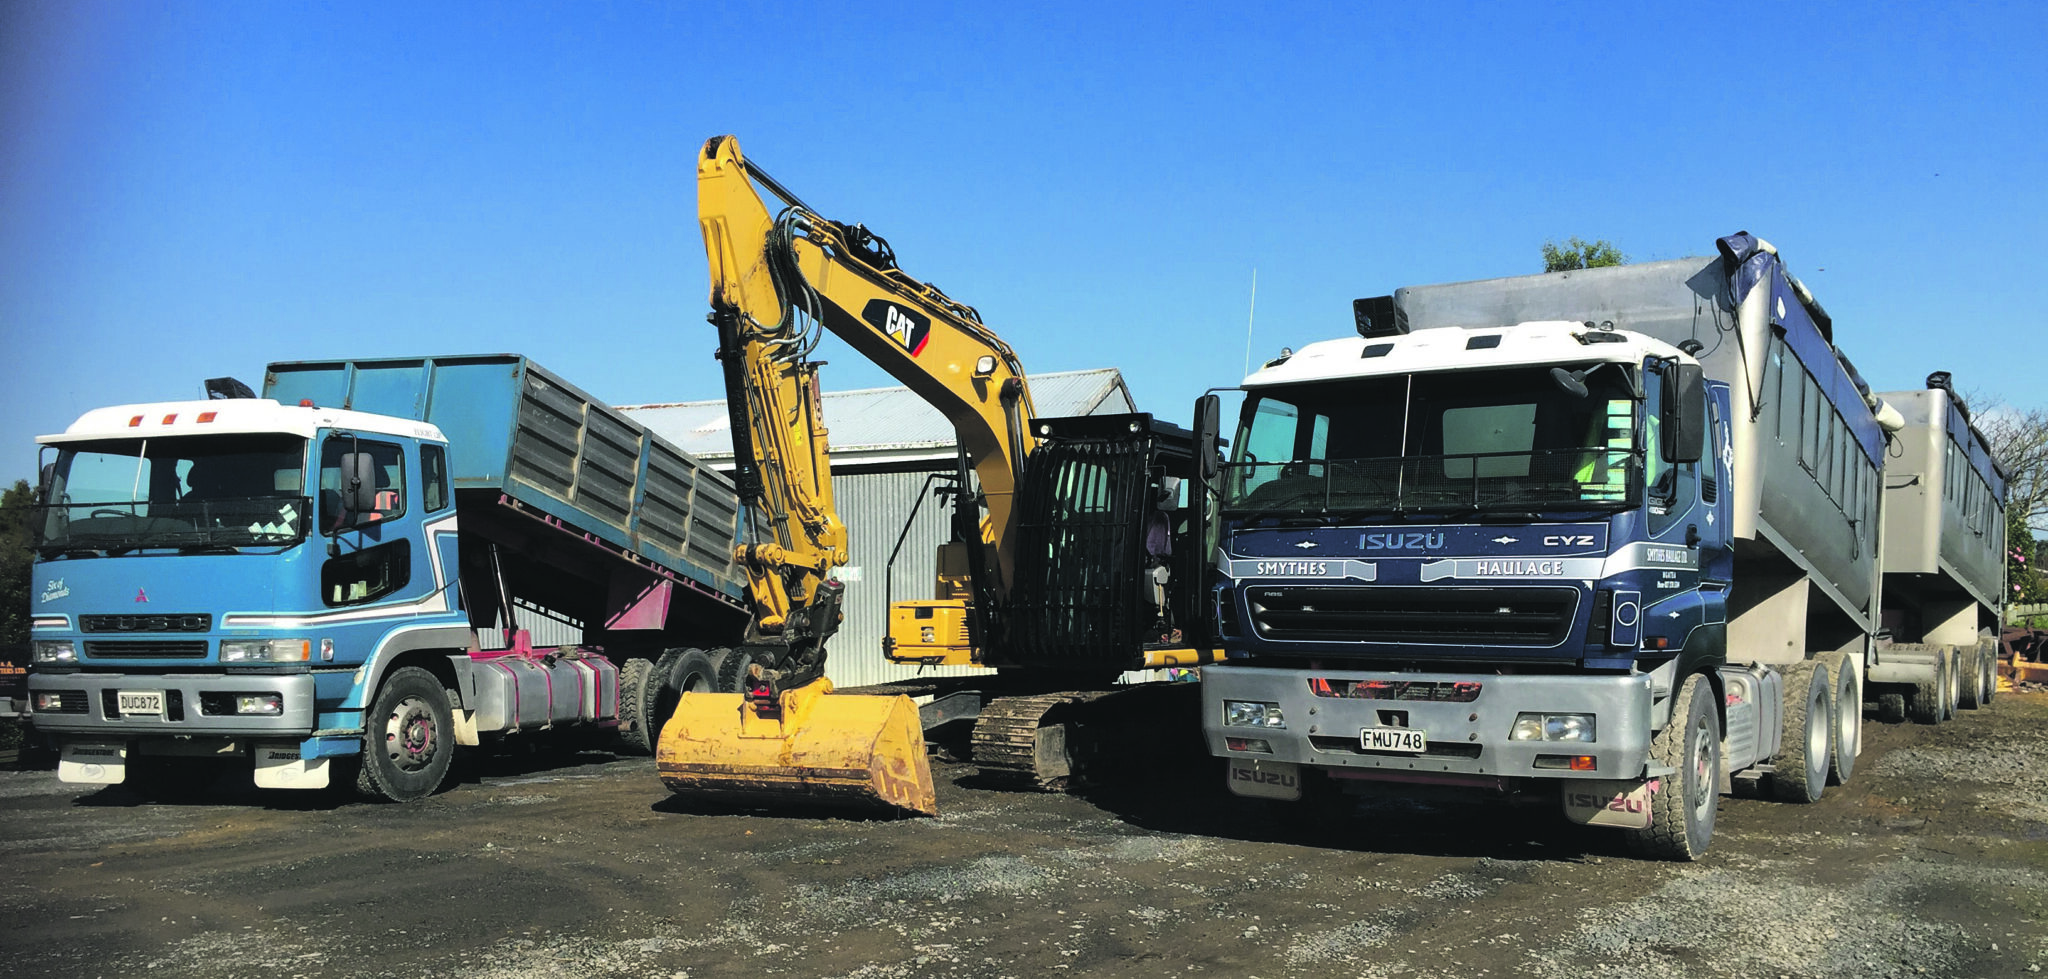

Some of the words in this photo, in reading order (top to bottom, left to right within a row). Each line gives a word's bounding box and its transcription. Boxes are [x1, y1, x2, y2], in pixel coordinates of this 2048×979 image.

[886, 305, 915, 349] CAT
[1359, 533, 1444, 550] ISUZU
[1543, 535, 1595, 546] CYZ
[1647, 548, 1665, 562] SMYTHES
[1665, 549, 1681, 563] HAULAGE
[1257, 562, 1327, 576] SMYTHES
[1476, 561, 1564, 576] HAULAGE
[90, 616, 202, 630] FUSO
[121, 696, 160, 710] DUC872
[1363, 731, 1422, 749] FMU748
[267, 751, 302, 760] BRIDGES
[1233, 767, 1295, 788] ISUZU
[1568, 793, 1643, 813] ISUZU
